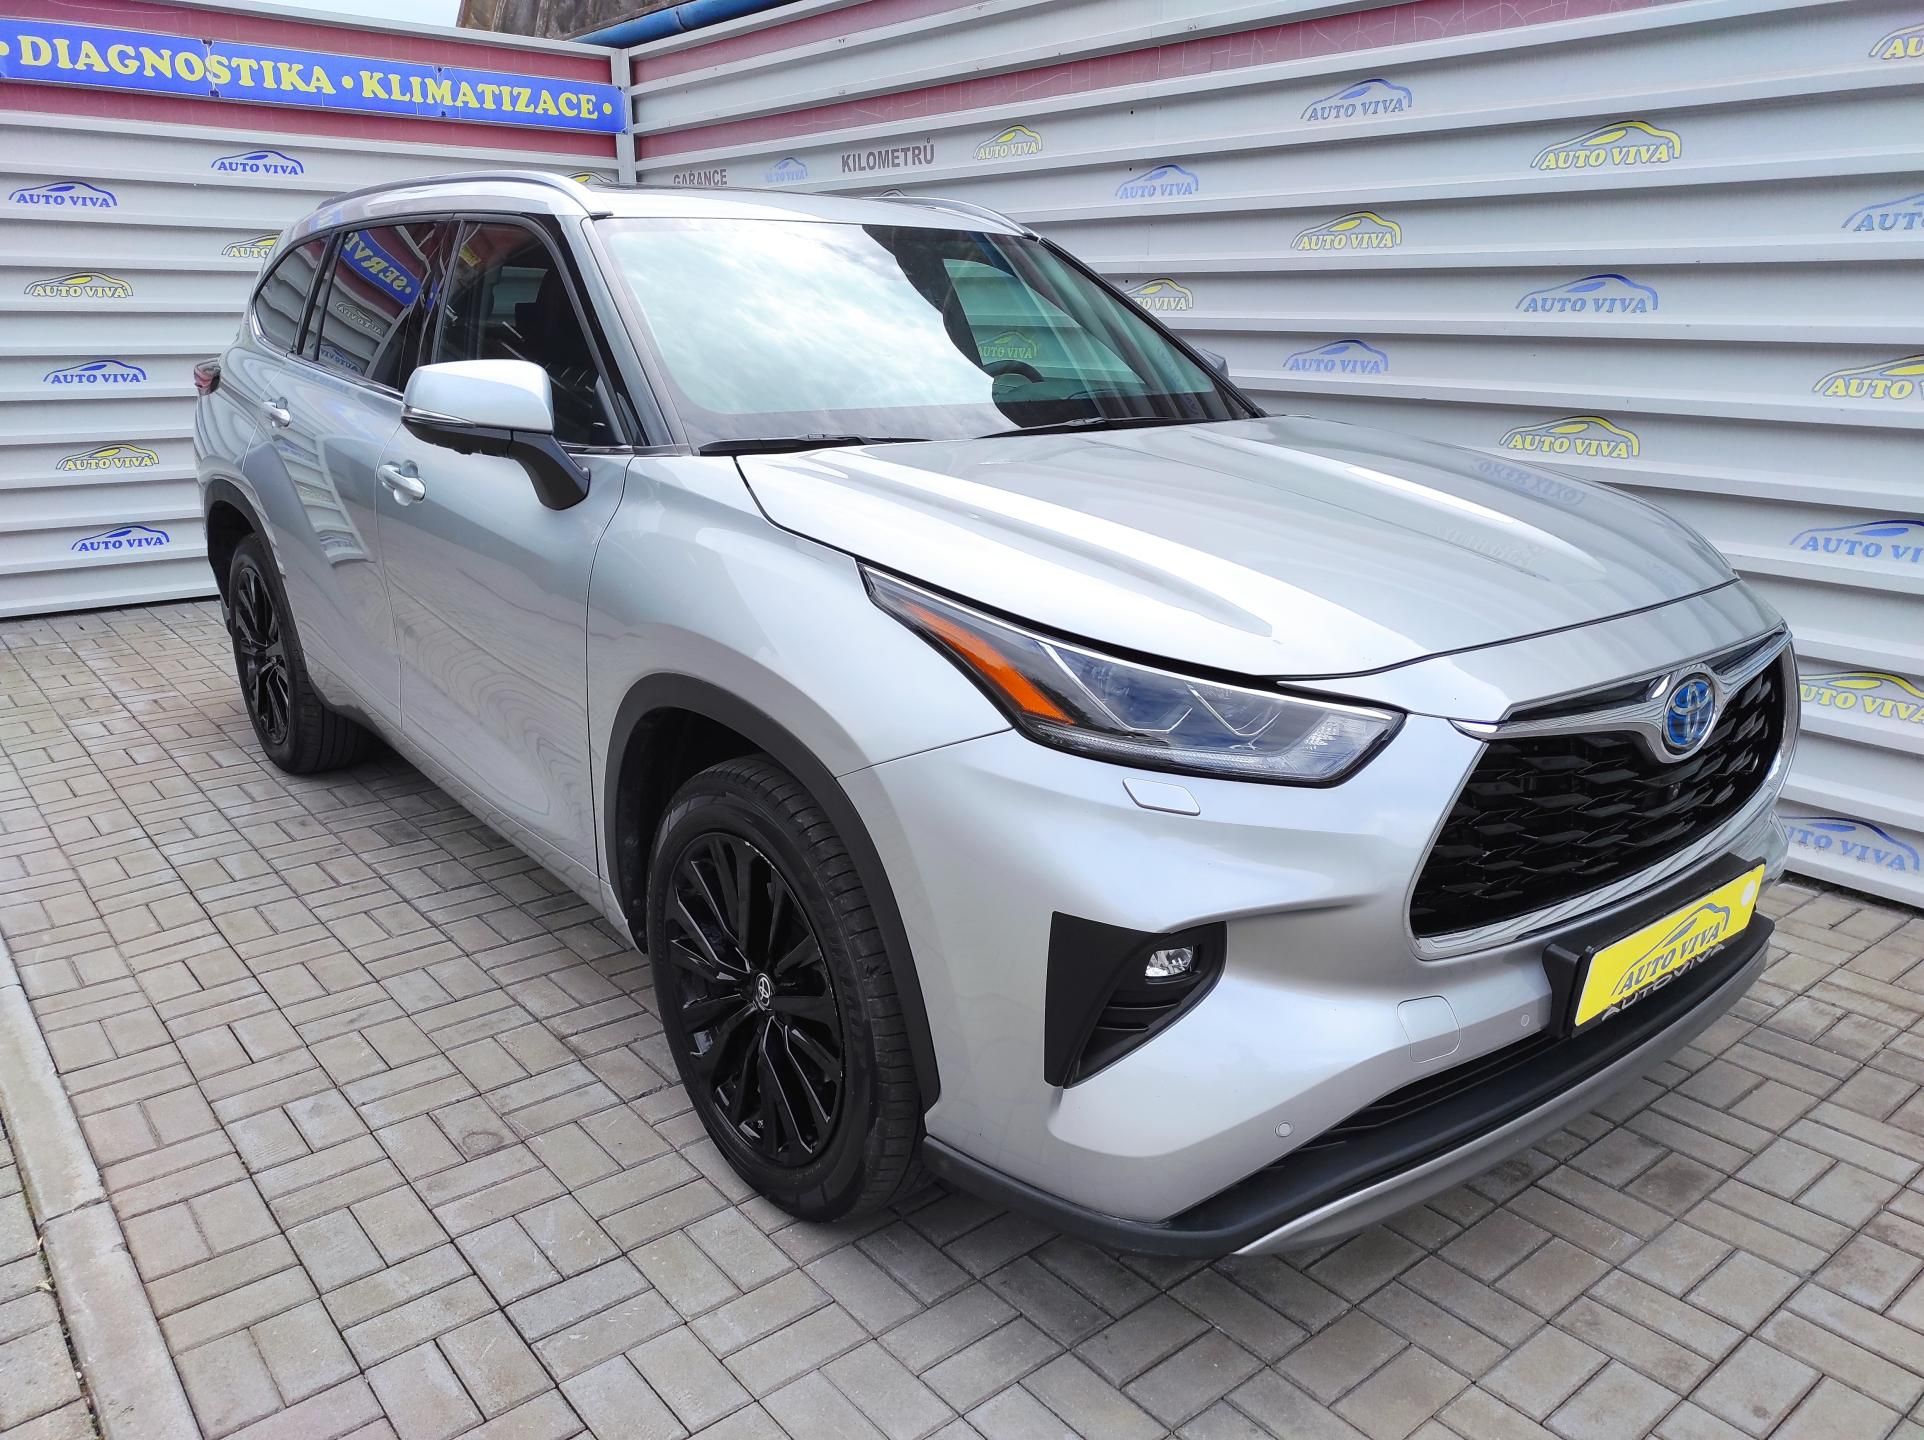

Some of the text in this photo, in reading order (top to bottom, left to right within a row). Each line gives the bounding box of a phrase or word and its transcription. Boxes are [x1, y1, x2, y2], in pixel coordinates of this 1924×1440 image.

[17, 35, 598, 120] DIAGNOSTIKA KLIMATIZACE
[1307, 97, 1404, 121] AUTO VIVA
[841, 137, 935, 173] KILOMETRŮ
[977, 142, 1038, 160] AUTO VIVA
[1539, 143, 1670, 170] AUTO VIVA
[217, 160, 299, 175] AUTO VIVA
[1120, 182, 1193, 199] AUTO VIVA
[16, 193, 111, 208] AUTO VIVA
[1297, 231, 1393, 251] AUTO VIVA
[32, 284, 127, 298] AUTO VIVA
[1154, 297, 1187, 310] VIVA
[1523, 297, 1647, 313] AUTO VIVA
[1289, 358, 1381, 374] AUTO VIVA
[51, 373, 141, 384] AUTO VIVA
[1823, 377, 1914, 401] AUTO
[1508, 434, 1629, 459] AUTO VIVA
[63, 456, 153, 471] AUTO VIVA
[78, 536, 164, 552] AUTO VIVA
[1801, 536, 1883, 558] AUTO
[1800, 683, 1857, 710] UTO
[1840, 839, 1905, 871] VIVA
[1618, 921, 1721, 996] AUTO VIVA
